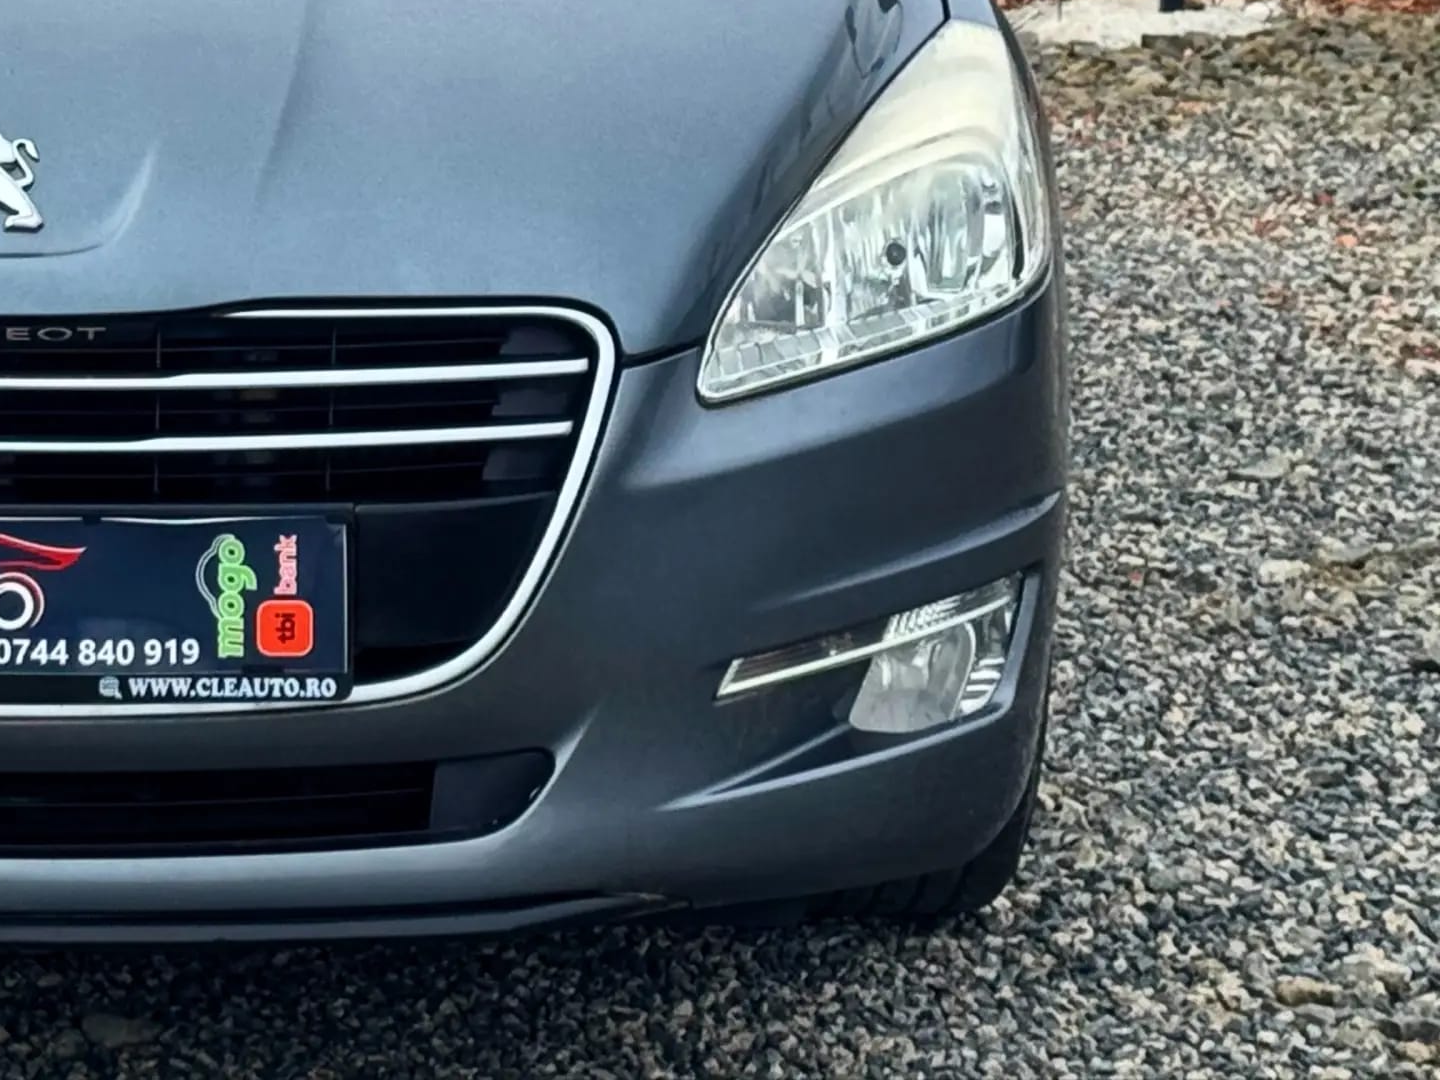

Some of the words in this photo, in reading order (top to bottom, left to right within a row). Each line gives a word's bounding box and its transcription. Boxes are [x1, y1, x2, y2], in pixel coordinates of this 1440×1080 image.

[273, 534, 297, 595] bank
[217, 538, 257, 658] mogo
[78, 638, 135, 666] 840
[144, 638, 200, 665] 919
[128, 677, 337, 698] WWW.CLEAUTO.RO
